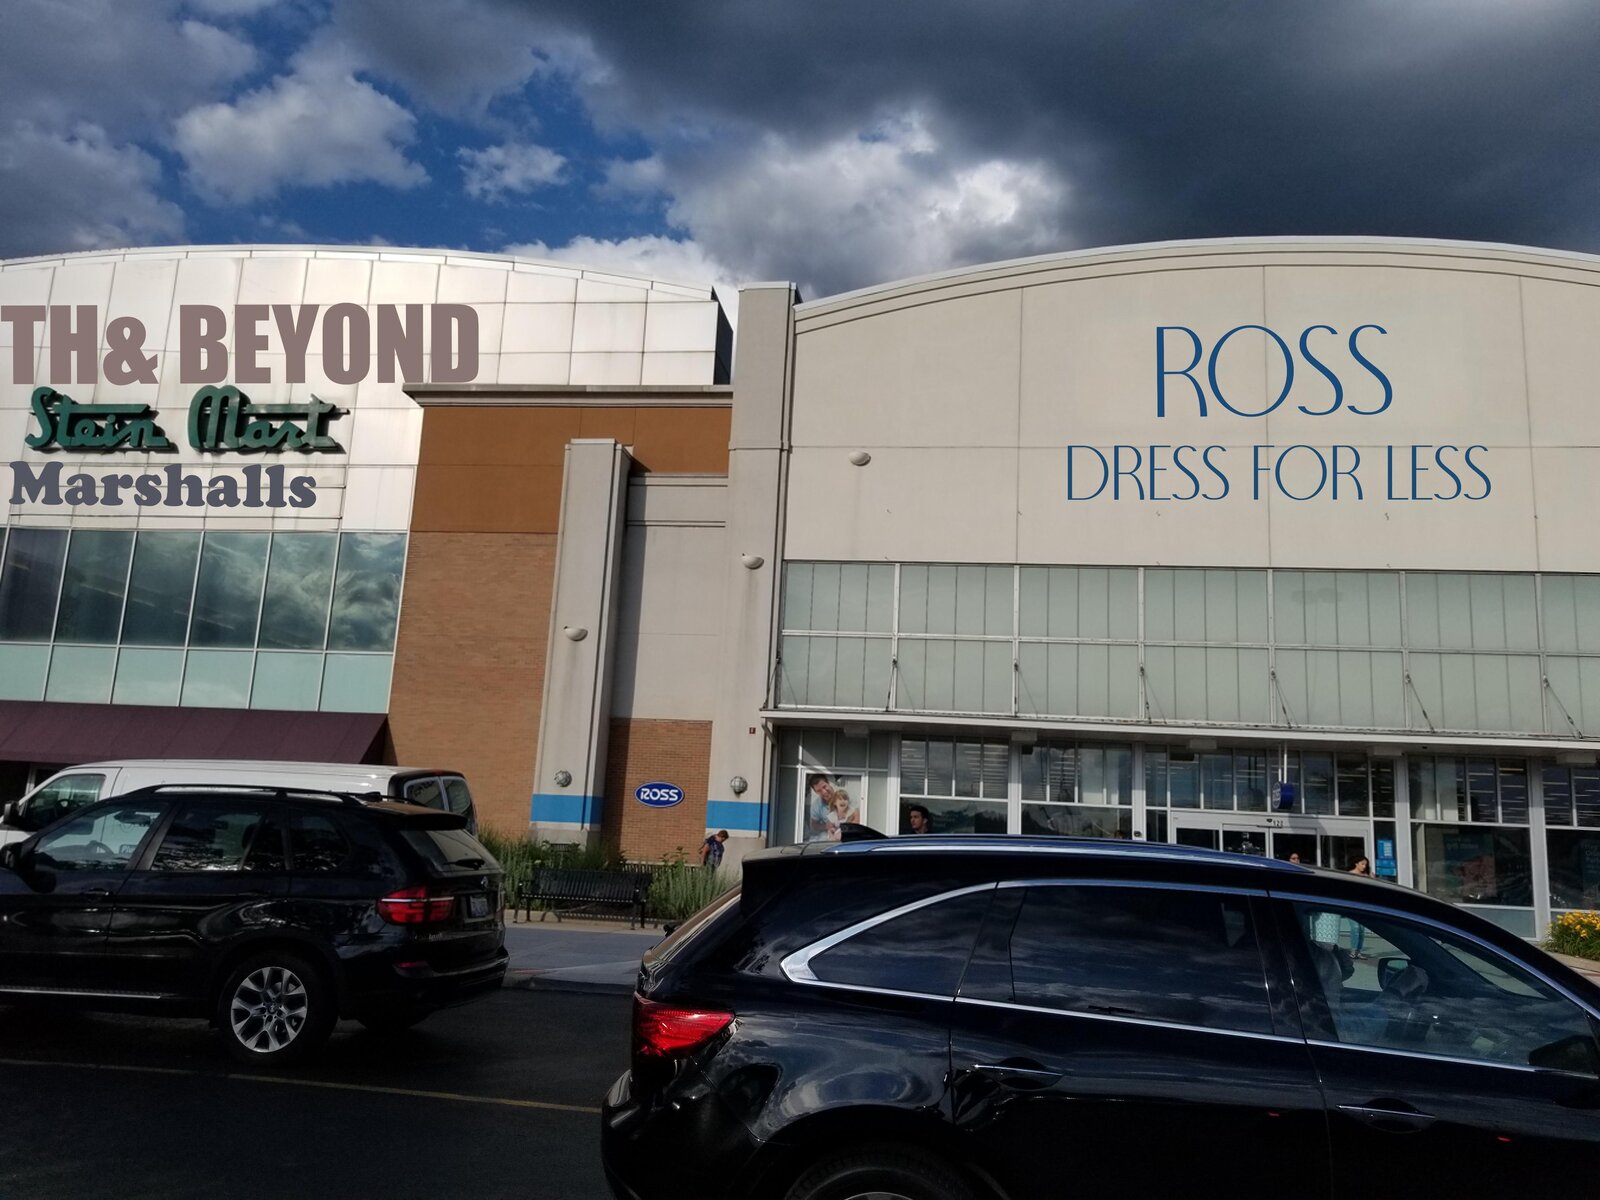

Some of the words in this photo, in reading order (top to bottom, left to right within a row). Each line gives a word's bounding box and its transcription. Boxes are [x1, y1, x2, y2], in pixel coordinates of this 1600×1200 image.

[180, 302, 479, 384] BEYOND
[1156, 325, 1393, 417] ROSS
[25, 386, 173, 452] Stein
[188, 386, 346, 452] Mart
[9, 461, 317, 508] Marshalls
[1067, 445, 1229, 500] DRESS
[1253, 445, 1363, 500] FOR
[1387, 445, 1492, 500] LESS
[640, 788, 679, 801] ROSS
